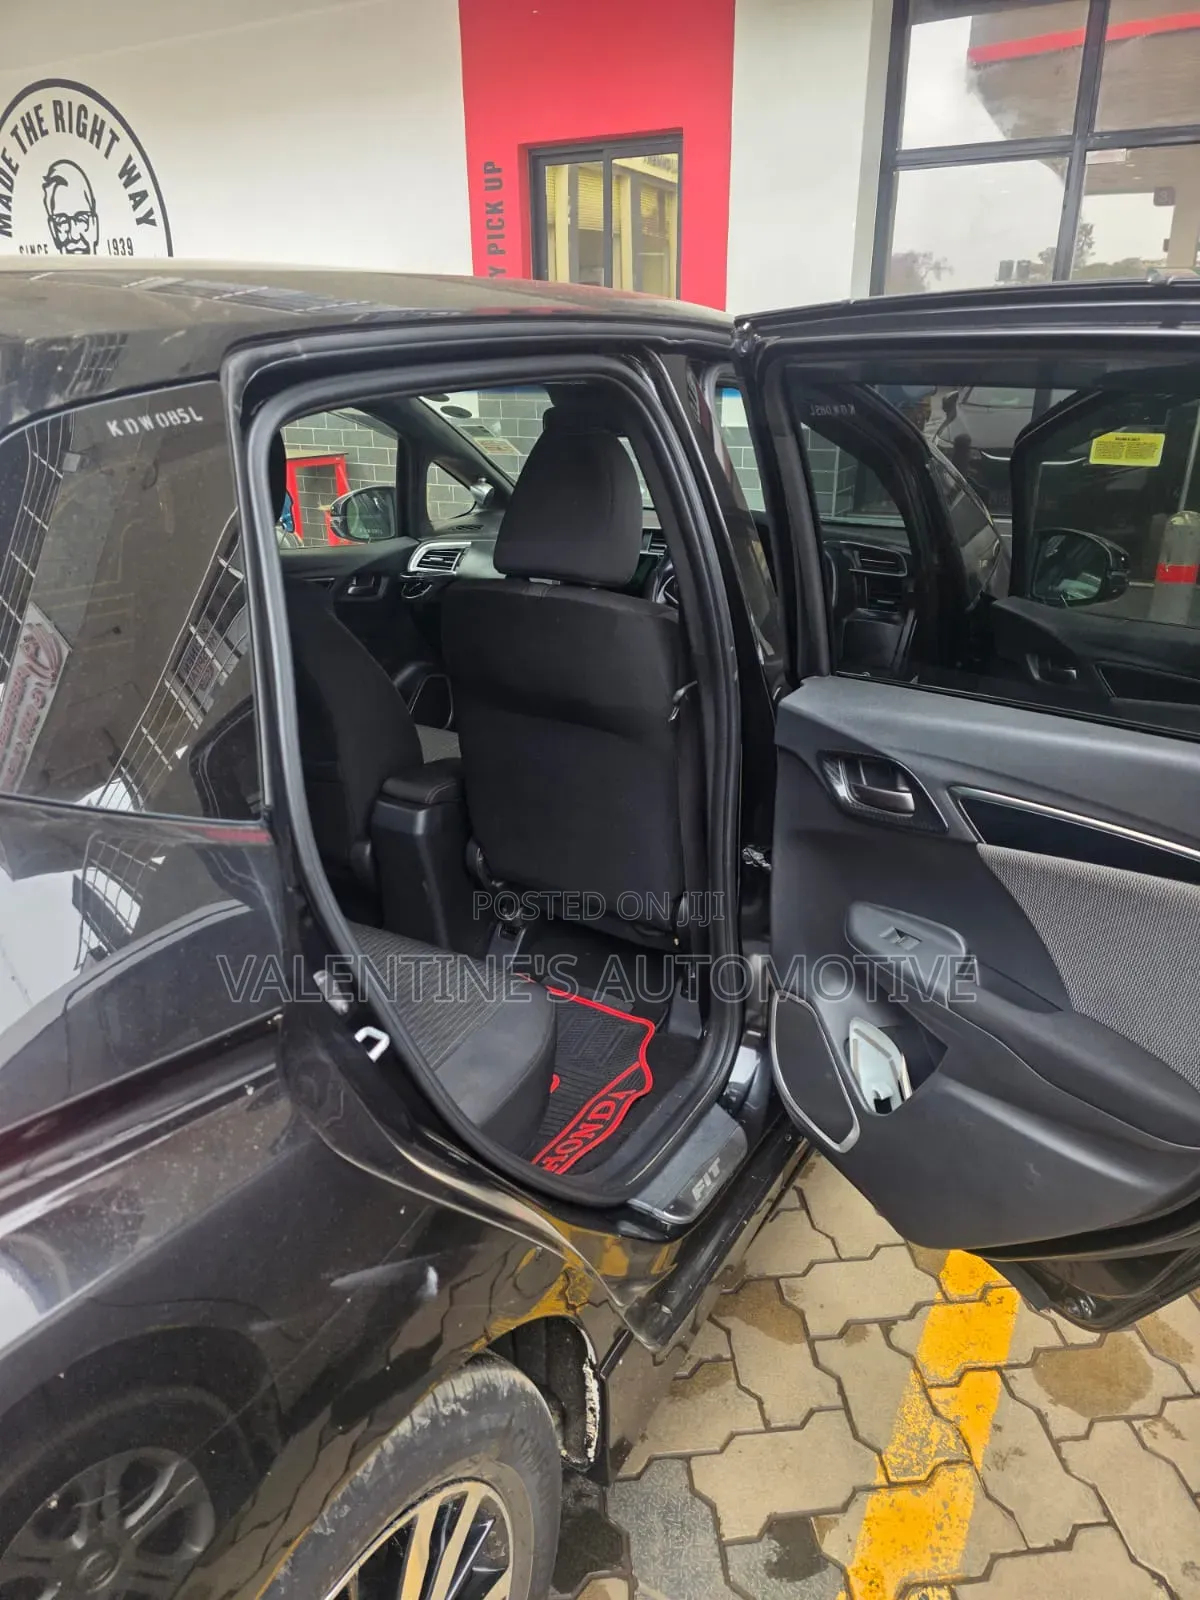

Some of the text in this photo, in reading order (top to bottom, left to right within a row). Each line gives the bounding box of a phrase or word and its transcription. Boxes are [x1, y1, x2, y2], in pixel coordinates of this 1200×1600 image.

[10, 104, 49, 155] THE
[52, 100, 120, 160] RIGHT
[118, 154, 158, 227] WAY
[484, 161, 503, 191] UP
[107, 237, 134, 256] 1939
[485, 201, 505, 256] PICK
[691, 1156, 720, 1201] FIT
